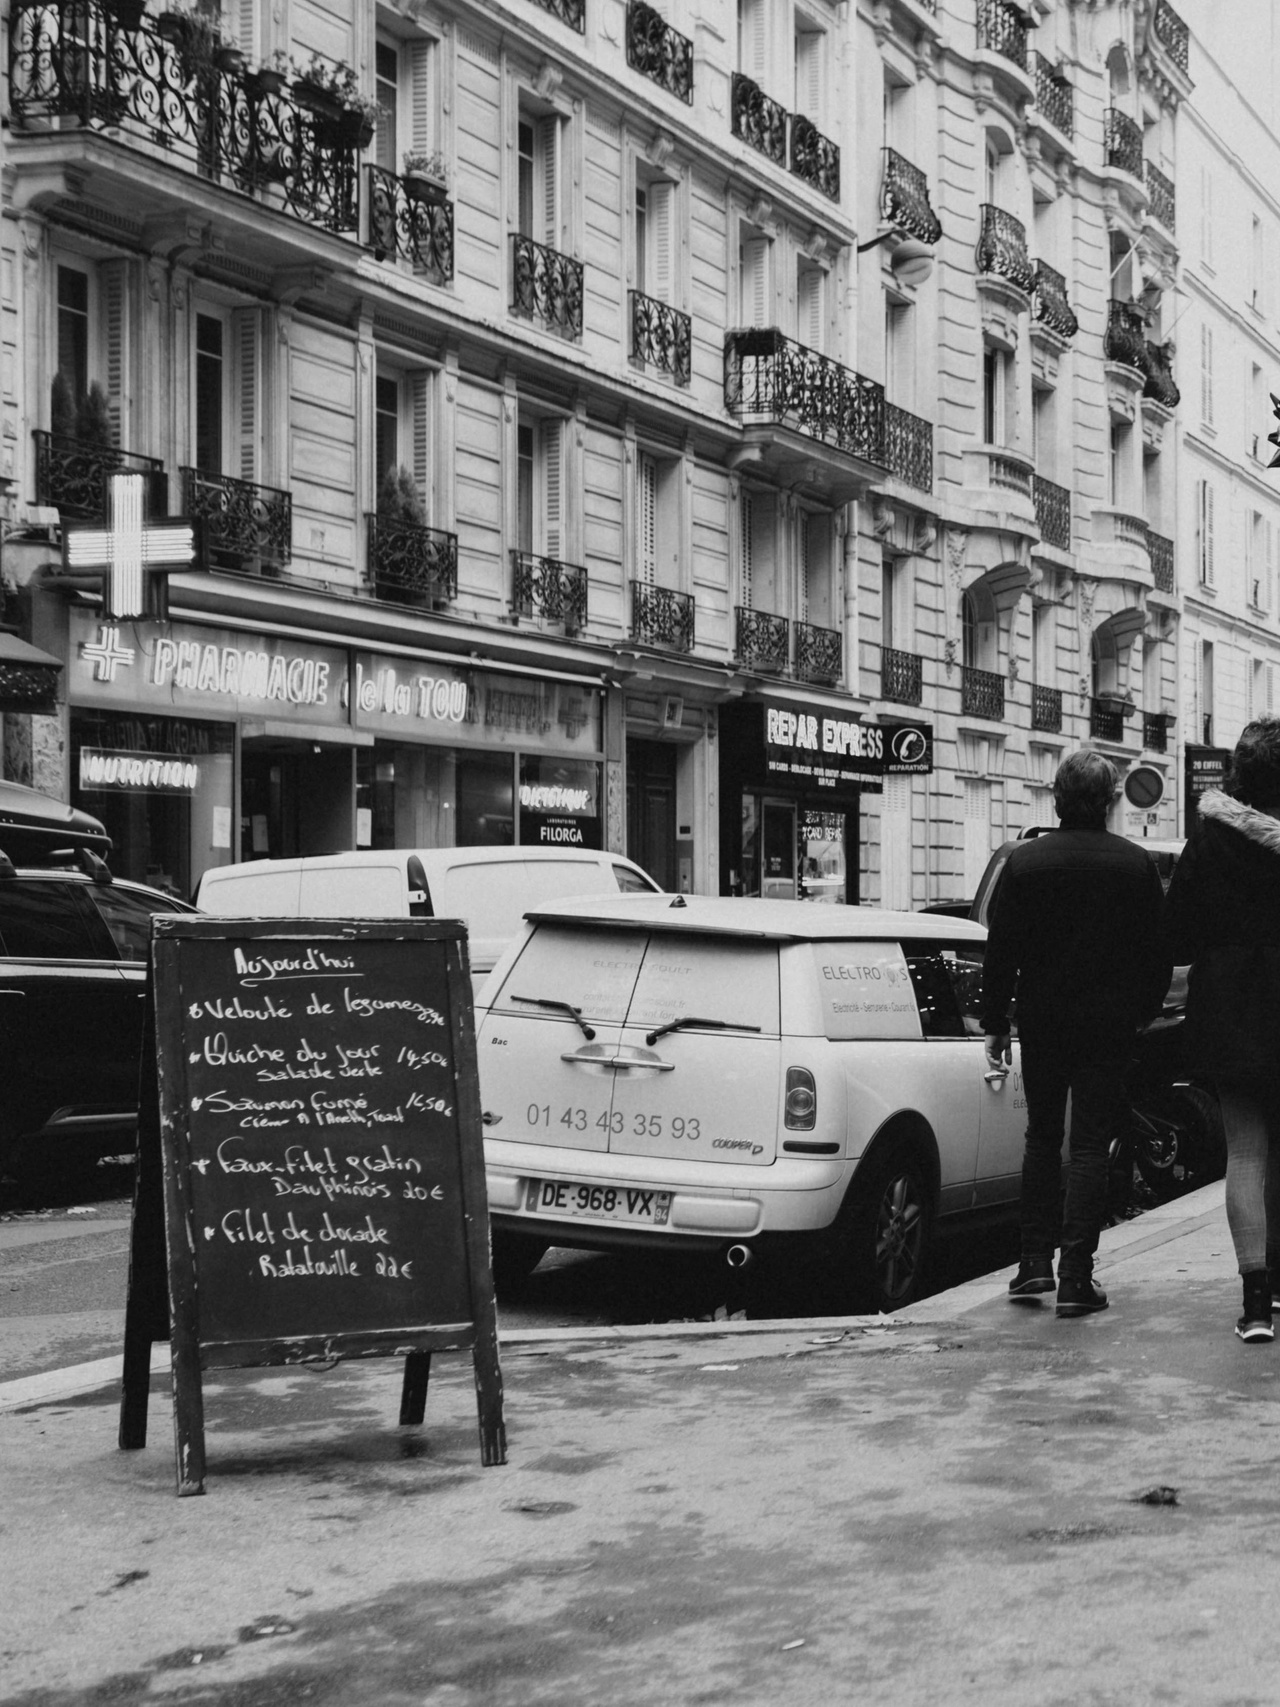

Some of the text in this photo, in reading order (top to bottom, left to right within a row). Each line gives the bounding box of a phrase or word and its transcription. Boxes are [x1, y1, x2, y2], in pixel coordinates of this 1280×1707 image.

[153, 638, 329, 706] PHARMACIE
[767, 708, 883, 760] REPAR EXPRESS
[89, 755, 198, 789] NUTRITION
[1203, 760, 1224, 770] EIFFEL
[540, 826, 584, 843] FILORGA
[233, 947, 355, 980] Aujourd'hui
[822, 966, 882, 980] ELECTRO
[305, 992, 335, 1015] de
[295, 1038, 327, 1062] du
[491, 1037, 509, 1046] Bac
[526, 1103, 701, 1141] 01 43 43 35 93
[711, 1137, 764, 1155] COOPER D
[270, 1174, 392, 1202] Dauphinois
[541, 1183, 655, 1216] DE-968-VX
[281, 1211, 314, 1242] de
[318, 1212, 392, 1245] dorade
[258, 1244, 363, 1278] Ratatouille
